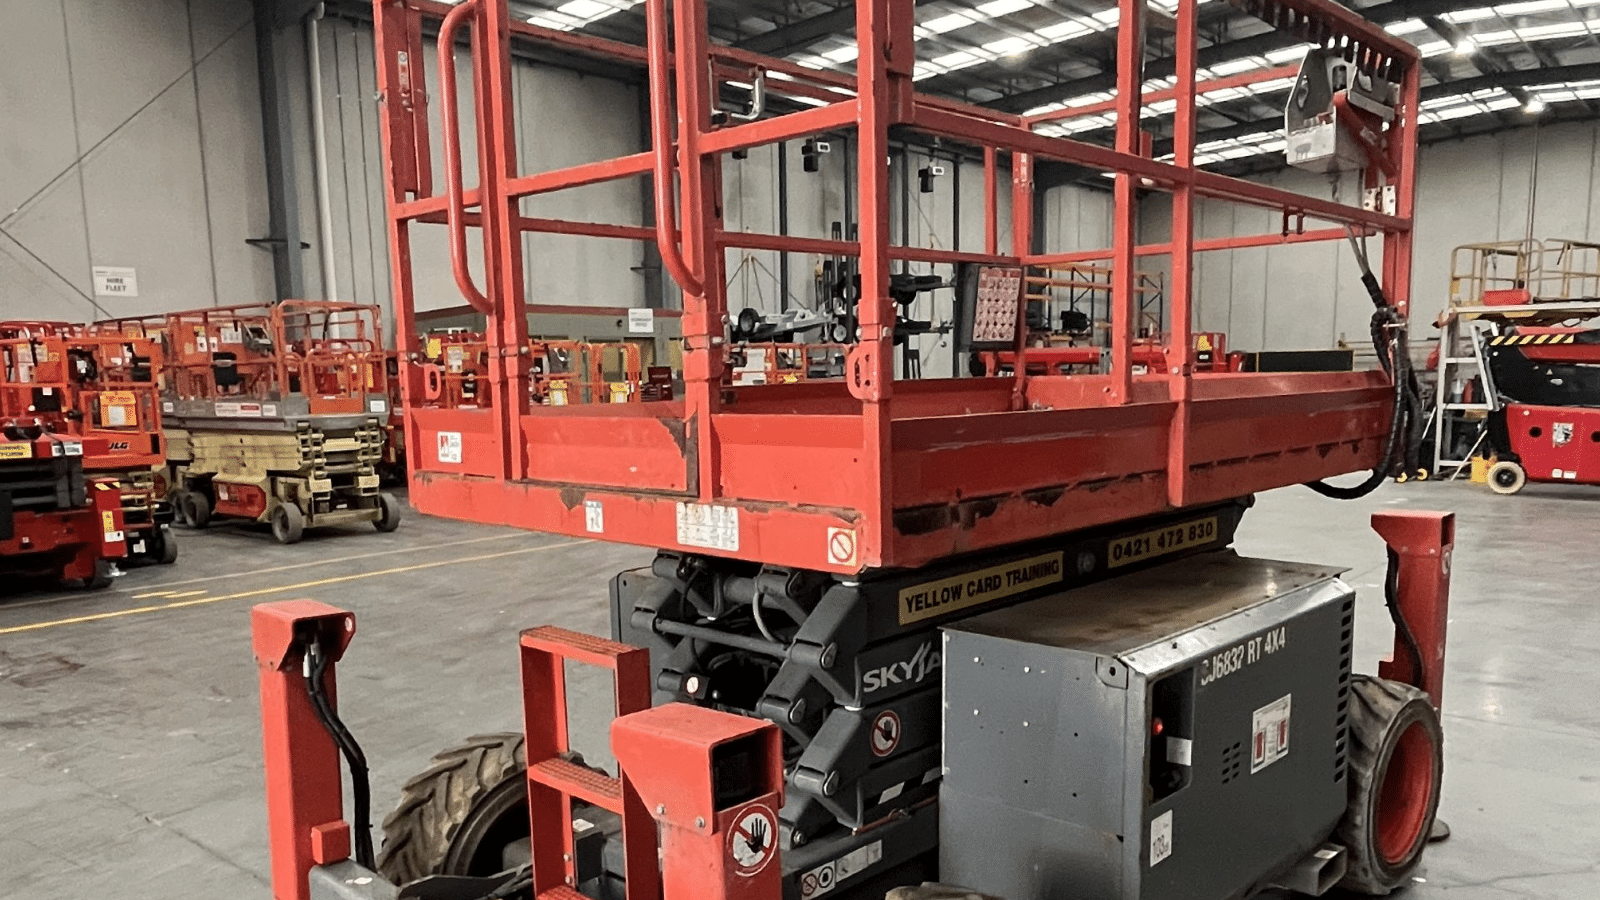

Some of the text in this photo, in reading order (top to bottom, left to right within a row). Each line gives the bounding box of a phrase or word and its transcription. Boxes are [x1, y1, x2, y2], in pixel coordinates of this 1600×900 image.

[108, 442, 128, 450] JLG
[1113, 521, 1213, 561] 0421 472 830
[905, 558, 1060, 613] YELLOW CARD TRAINING
[1247, 636, 1263, 665] RT
[1264, 626, 1286, 654] 4X4
